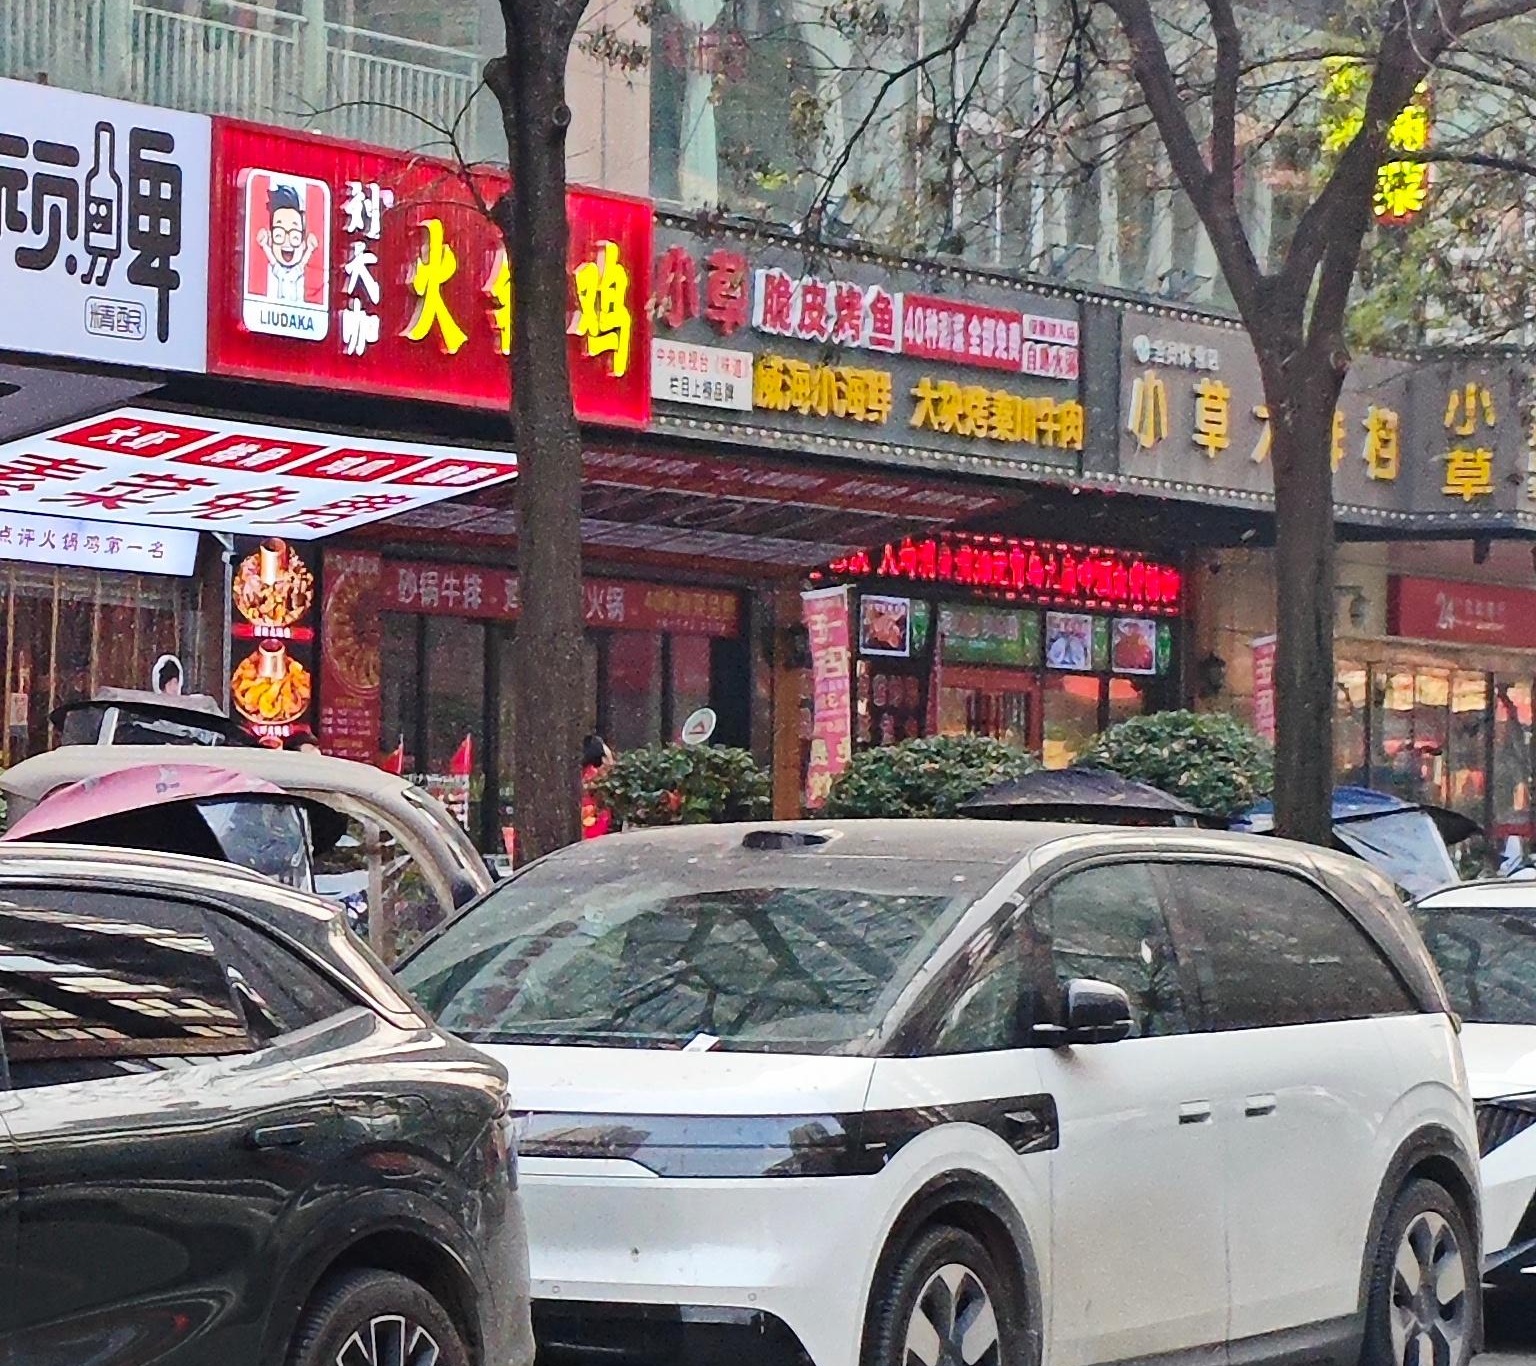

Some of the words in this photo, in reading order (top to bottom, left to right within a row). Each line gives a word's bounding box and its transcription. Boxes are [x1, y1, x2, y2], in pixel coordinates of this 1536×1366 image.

[340, 181, 384, 356] 刘大咖
[756, 268, 901, 355] 脆皮烤鱼
[259, 309, 315, 333] LIUDAKA
